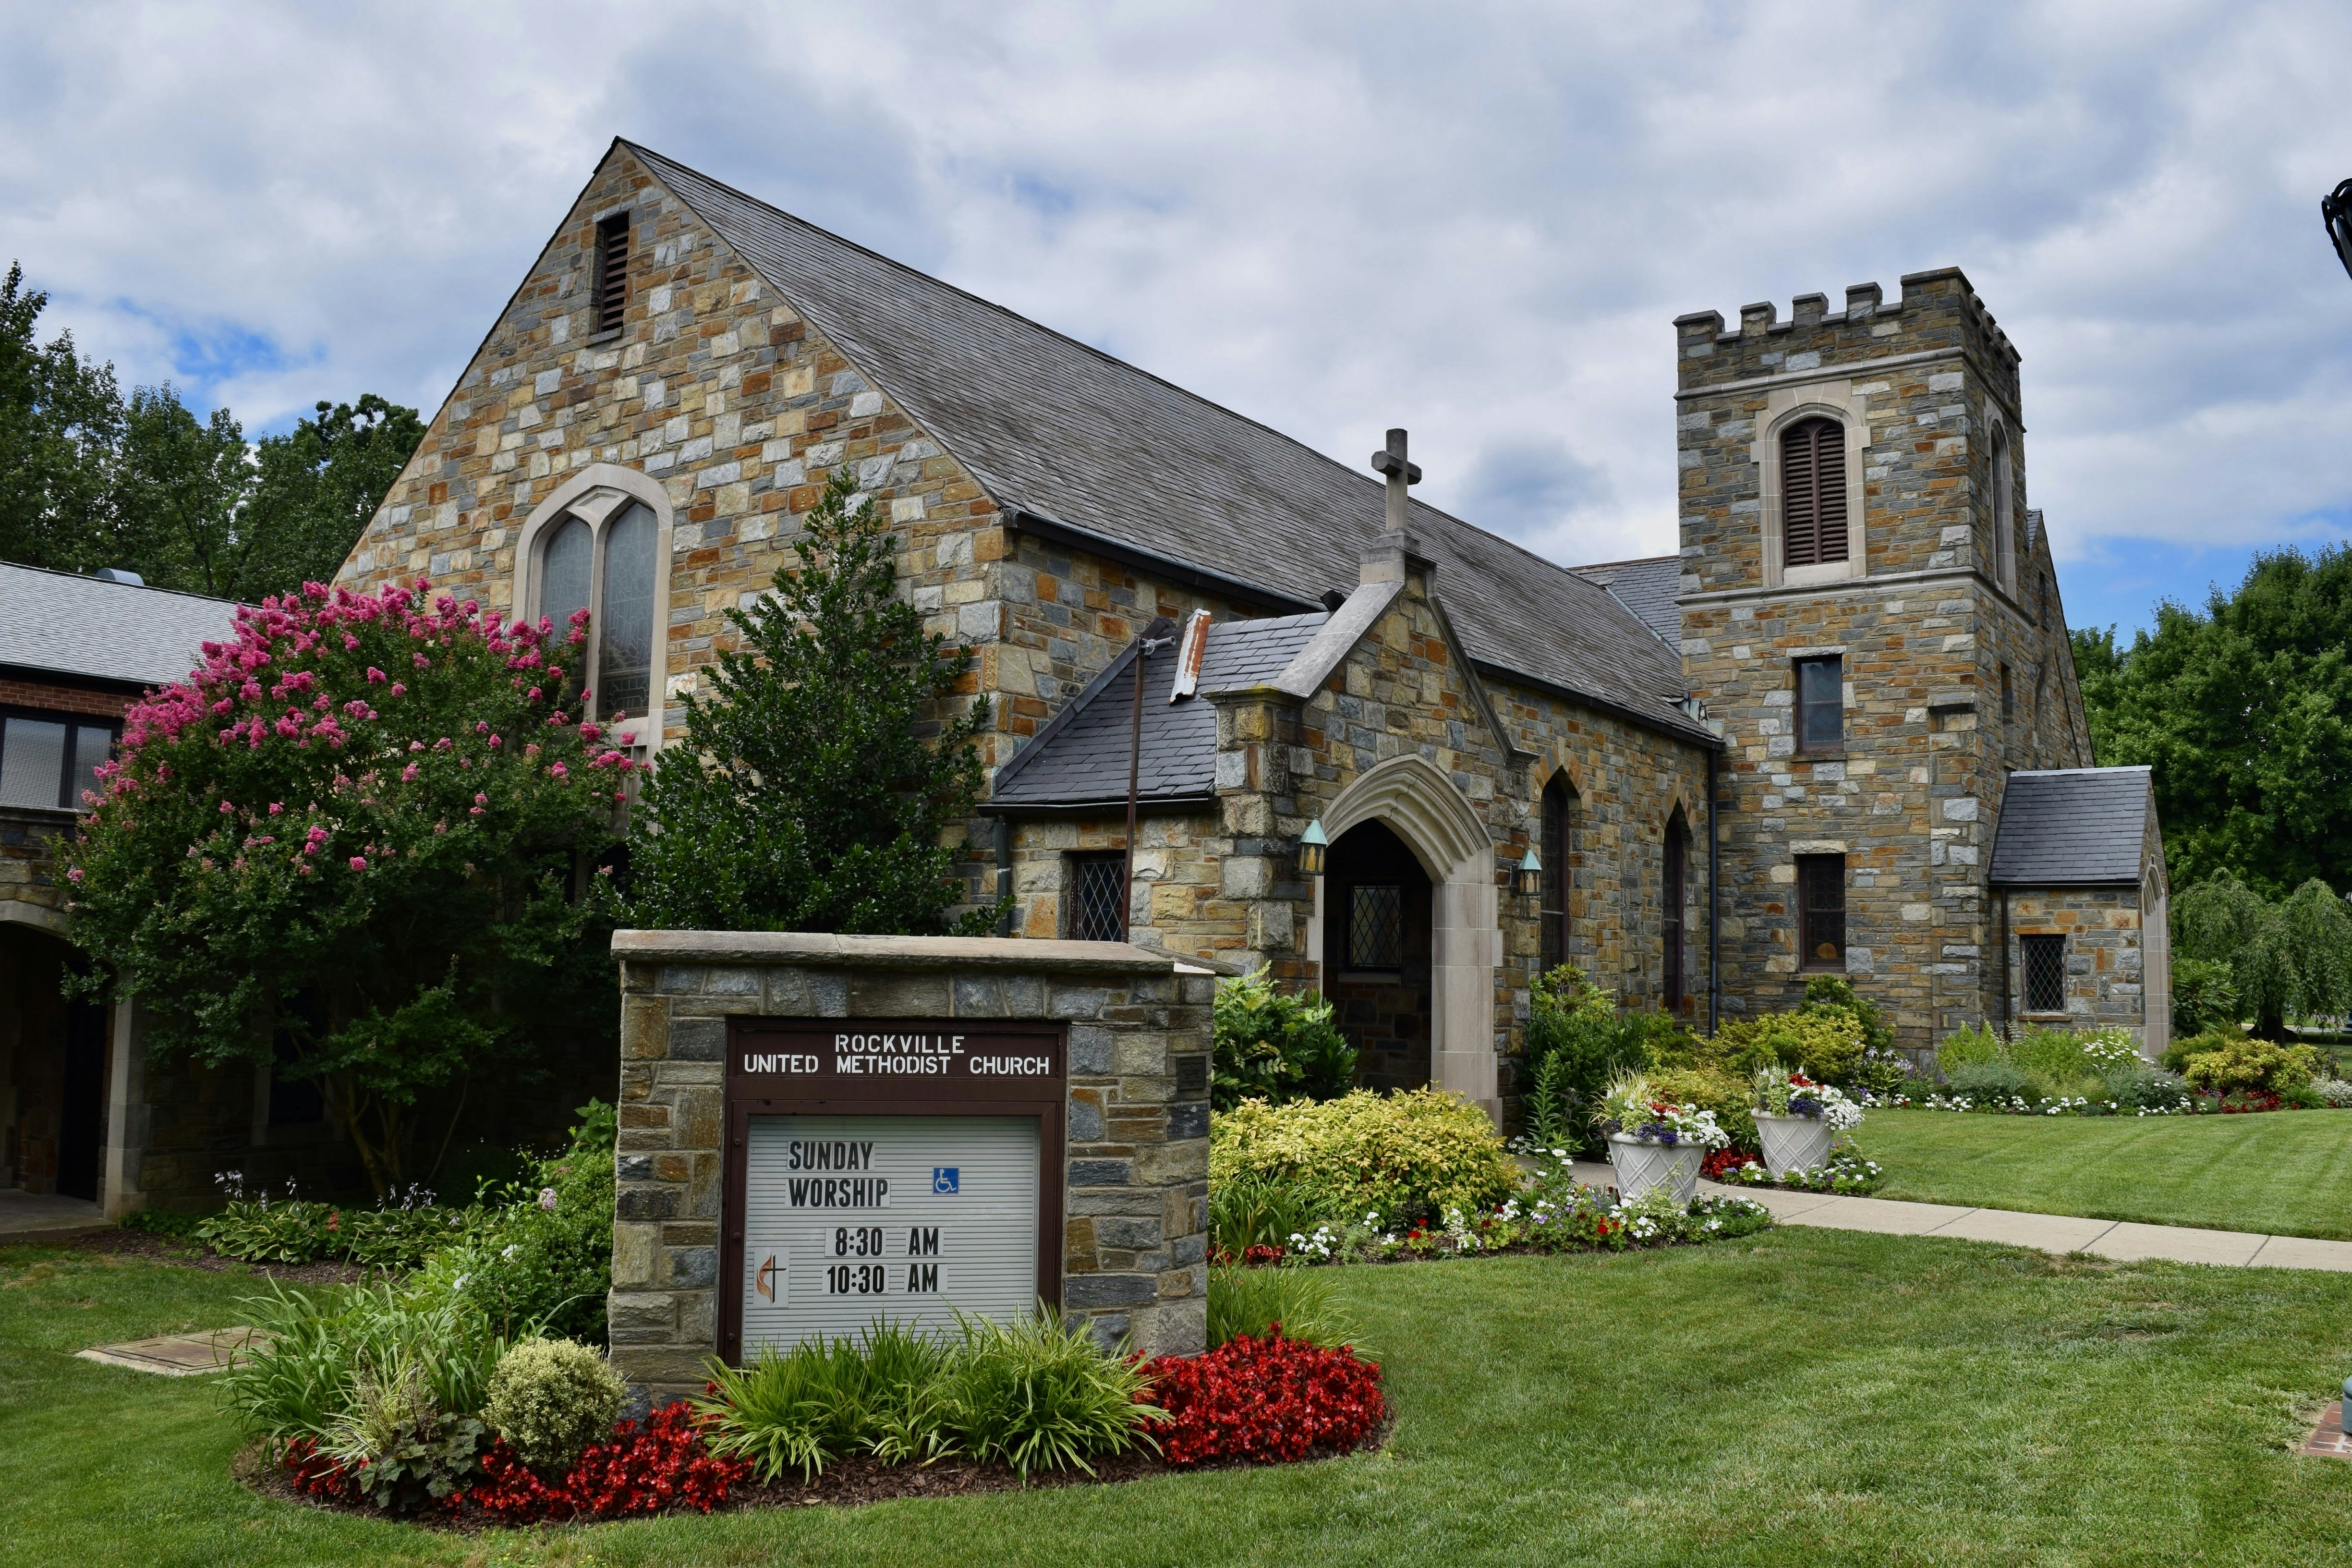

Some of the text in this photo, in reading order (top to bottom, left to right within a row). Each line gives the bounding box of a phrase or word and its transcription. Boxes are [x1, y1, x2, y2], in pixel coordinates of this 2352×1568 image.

[835, 1034, 964, 1054] ROCKVILLE
[744, 1054, 1049, 1075] UNITED METHODIST CHURCH
[789, 1141, 873, 1169] SUNDAY
[788, 1178, 888, 1207] WORSHIP
[835, 1227, 939, 1256] 8:30 AM
[827, 1264, 938, 1294] 10:30 AM
